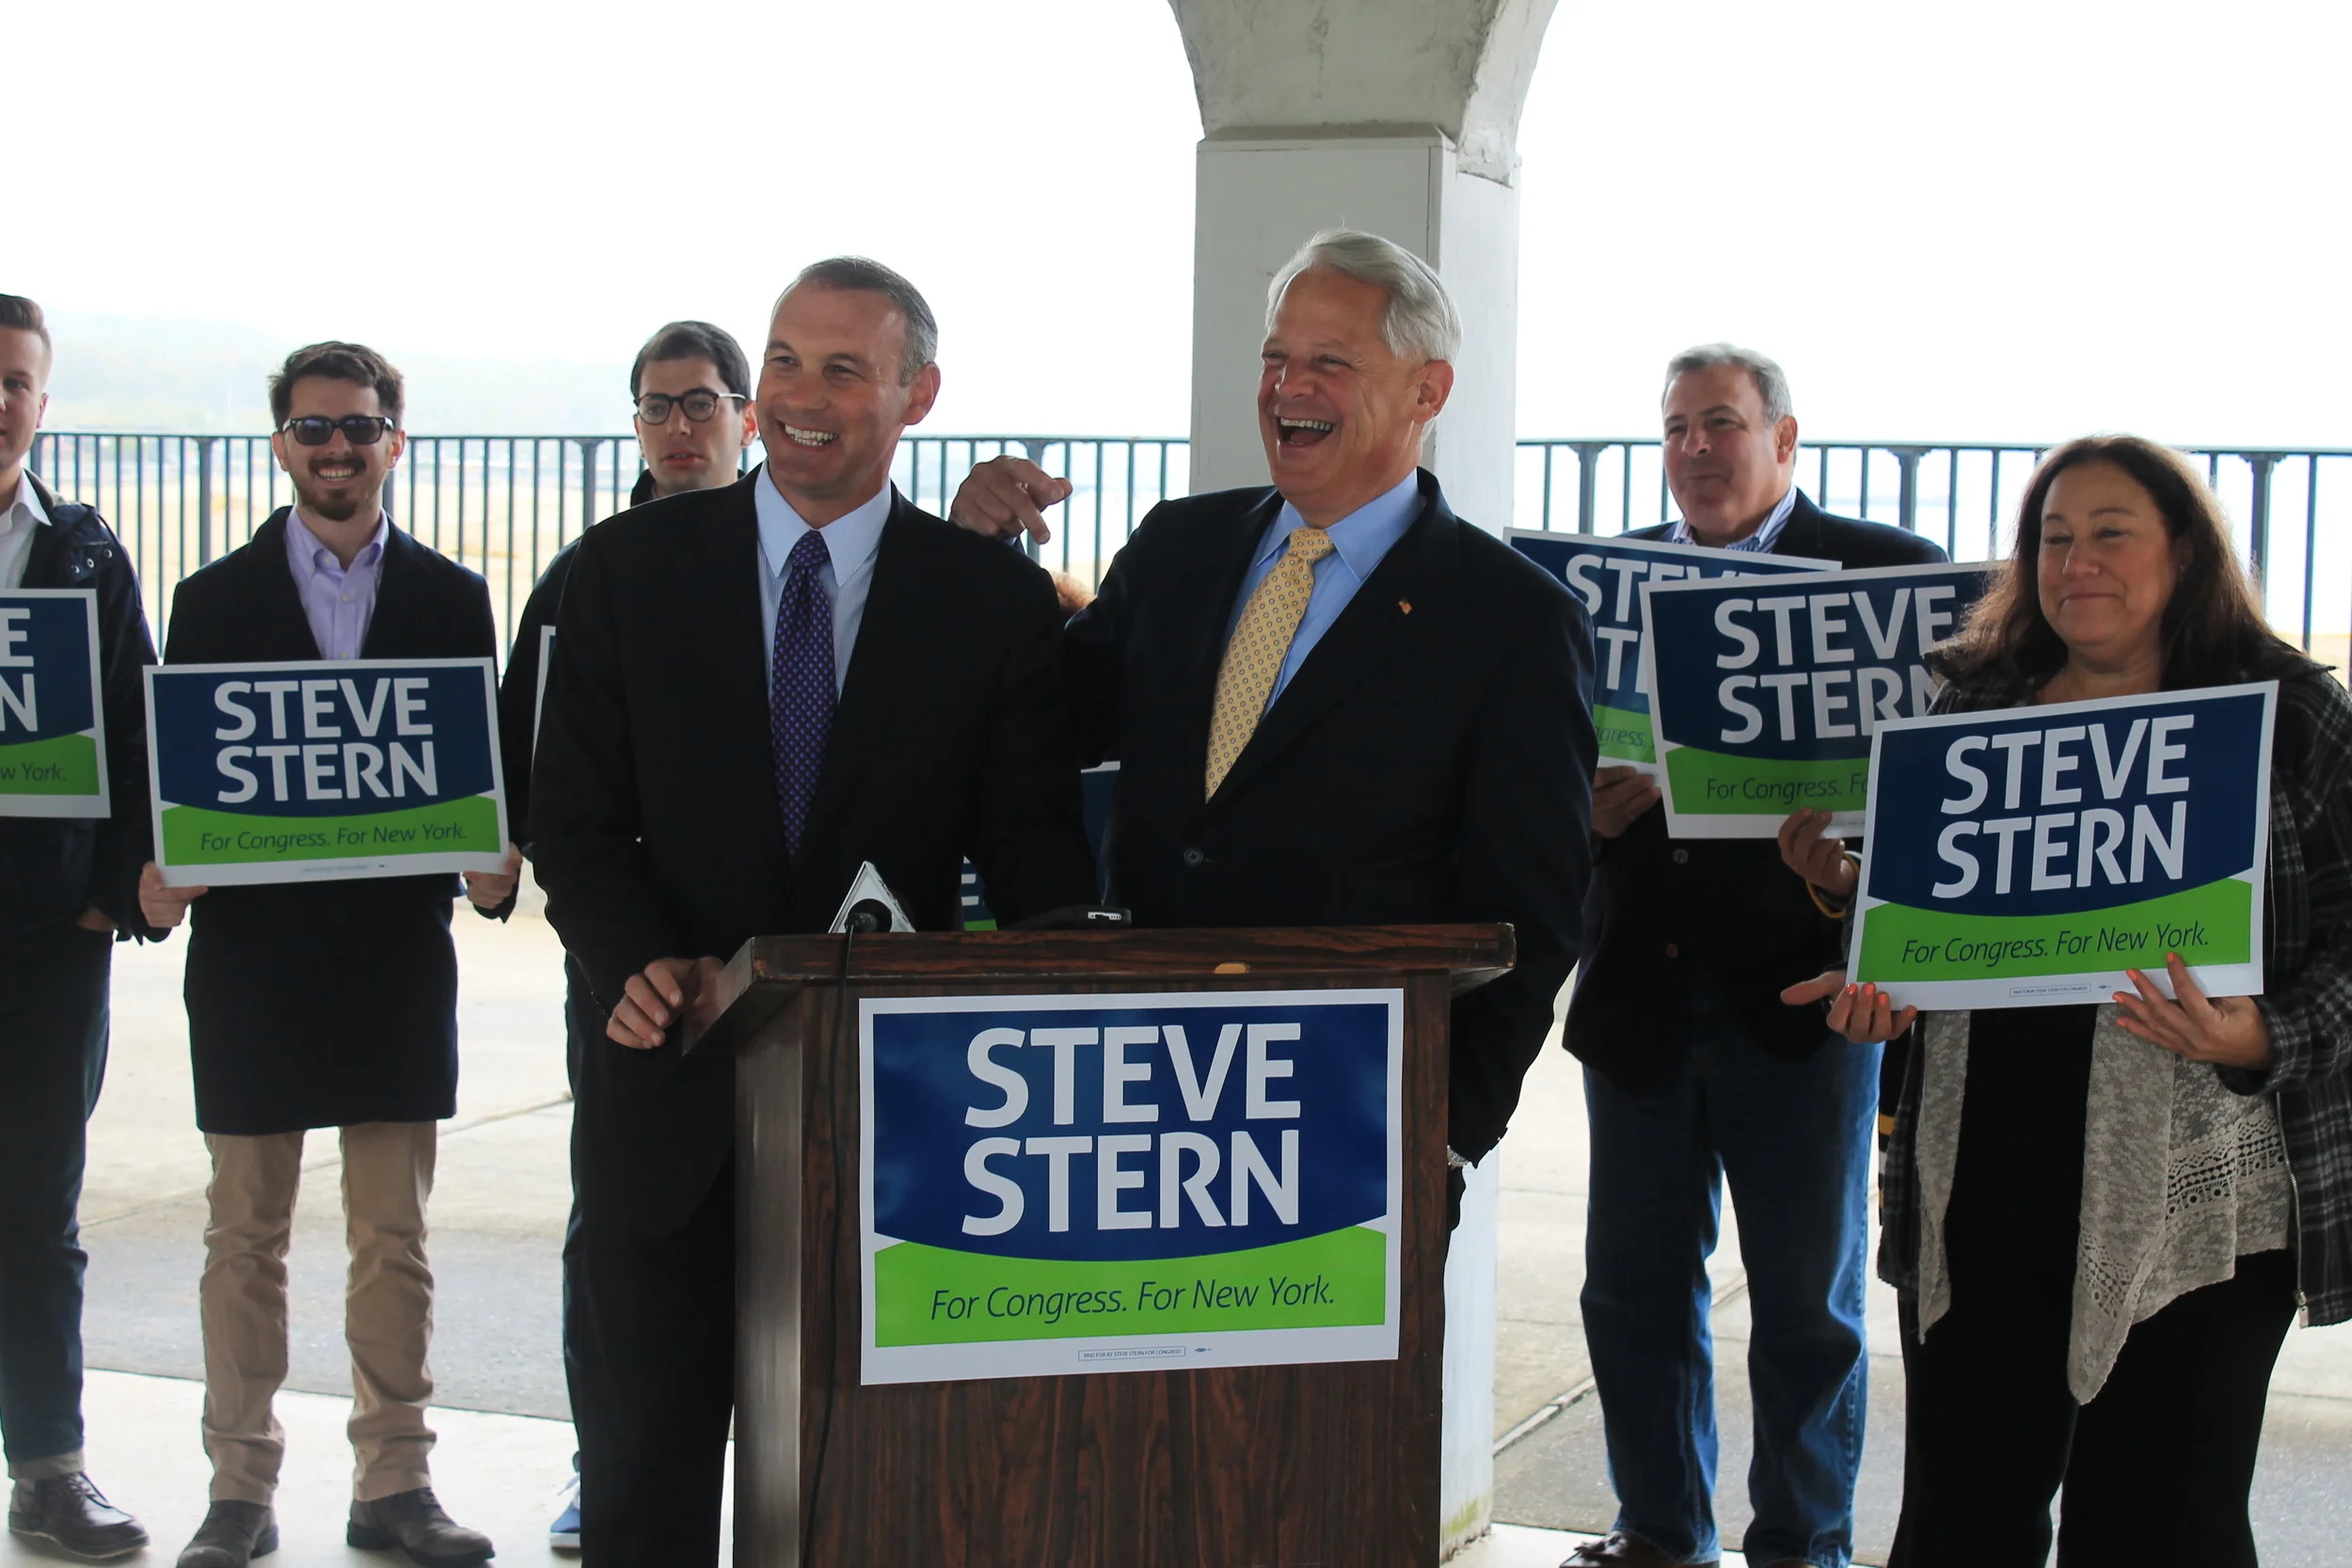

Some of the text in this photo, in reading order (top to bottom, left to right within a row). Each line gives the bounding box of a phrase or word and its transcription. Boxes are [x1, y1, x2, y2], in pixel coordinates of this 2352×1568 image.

[215, 677, 433, 741] STEVE
[21, 762, 67, 782] York.
[216, 741, 438, 803] STERN
[1707, 778, 1740, 800] For
[1743, 778, 1842, 805] Congress.
[1941, 714, 2195, 815] STEVE
[200, 822, 468, 854] For Congress. For New York.
[1931, 800, 2187, 898] STERN
[1901, 921, 2209, 968] For Congress. For New York.
[964, 1023, 1301, 1128] STEVE
[961, 1130, 1298, 1236] STERN
[930, 1275, 1334, 1325] For Congress. For New York.
